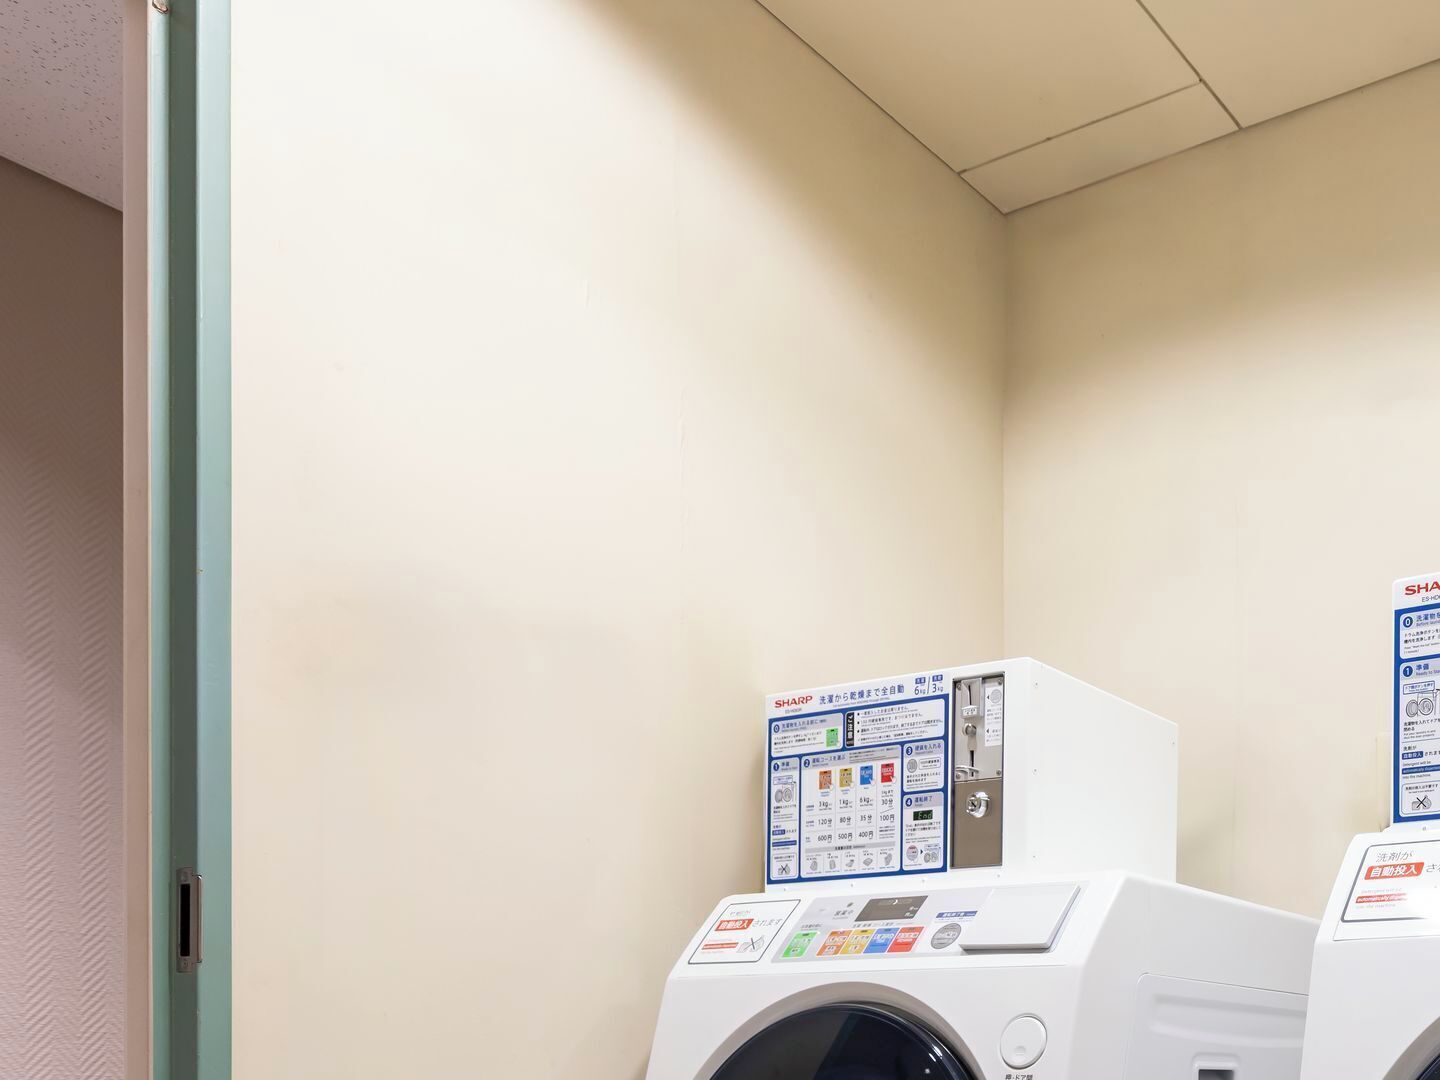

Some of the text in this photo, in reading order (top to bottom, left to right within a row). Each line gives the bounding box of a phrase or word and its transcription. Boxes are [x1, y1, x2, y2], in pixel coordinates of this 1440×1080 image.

[1405, 618, 1411, 626] 0
[1406, 667, 1410, 676] 1
[1416, 663, 1429, 671] 準備
[820, 684, 904, 705] 洗濯から乾燥まで全自動
[775, 696, 812, 708] SHARP
[1376, 851, 1414, 863] 洗剤が
[1371, 865, 1418, 877] 自動投入
